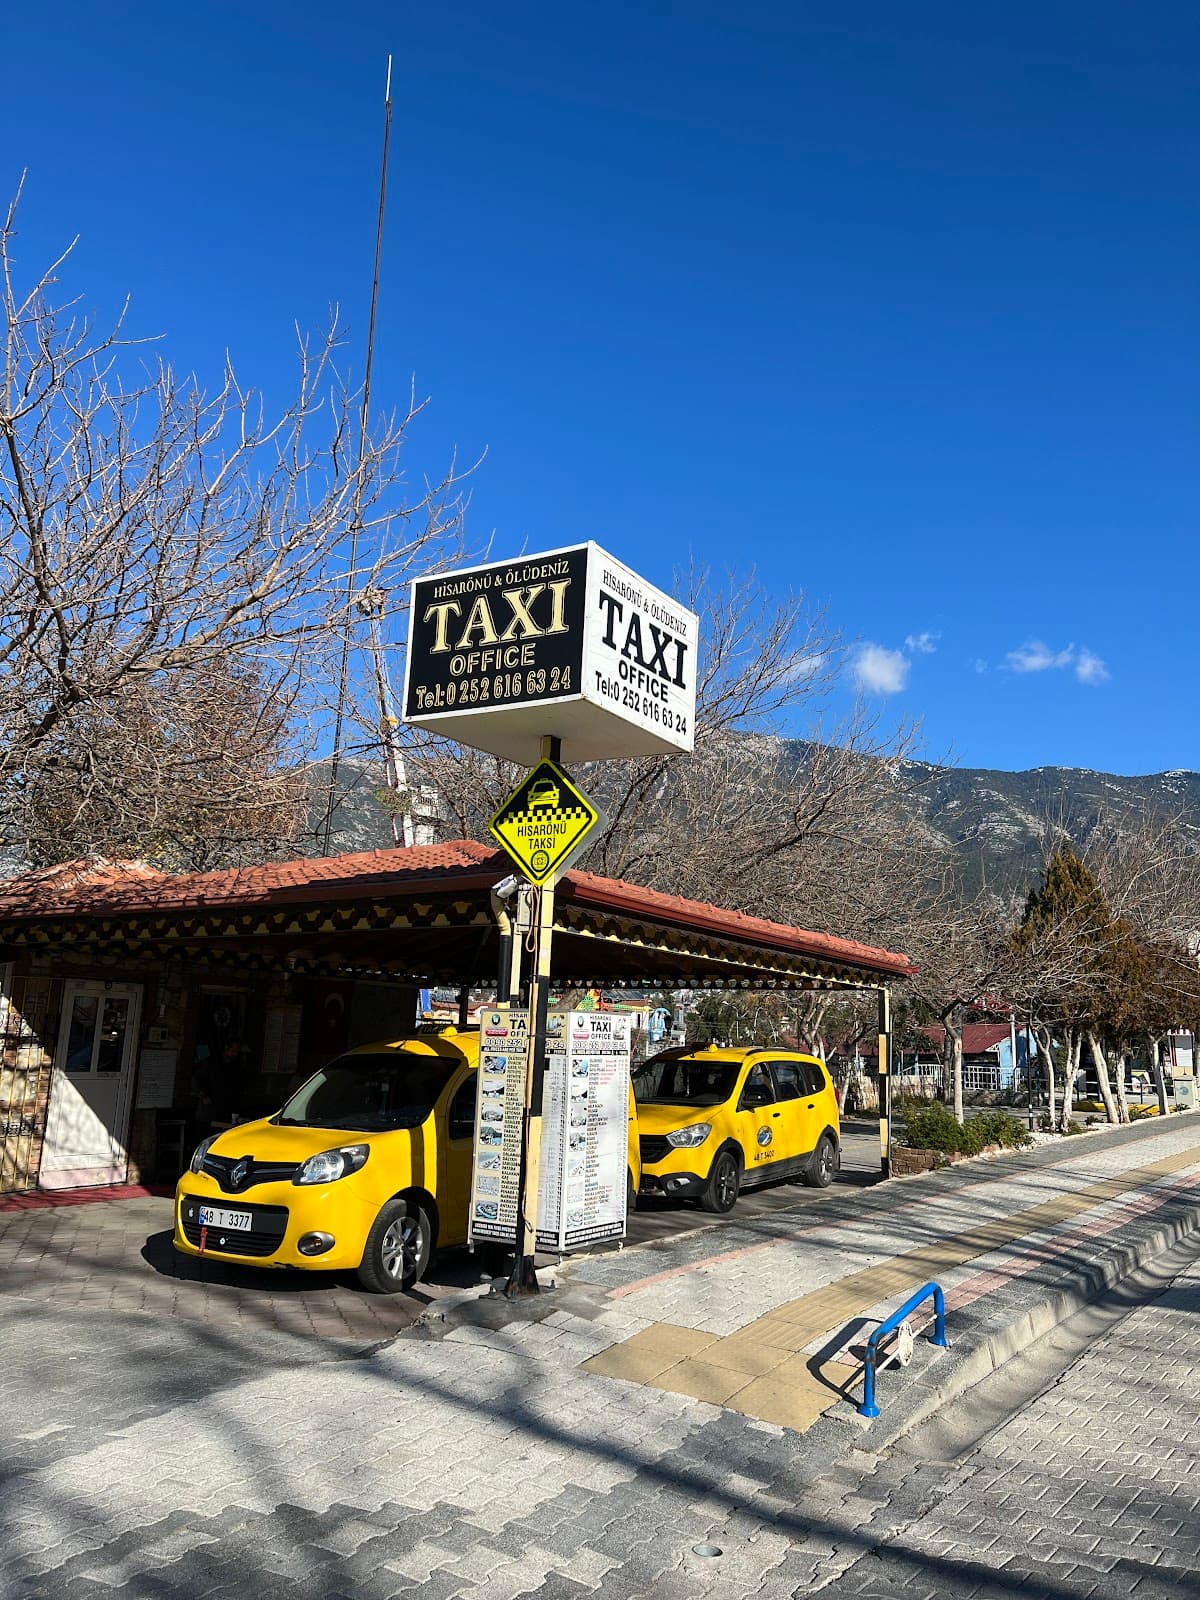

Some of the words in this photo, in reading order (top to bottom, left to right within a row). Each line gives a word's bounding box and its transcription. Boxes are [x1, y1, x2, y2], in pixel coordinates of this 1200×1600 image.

[434, 573, 492, 599] HİSARÖNÜ
[493, 574, 503, 587] &
[505, 558, 570, 585] ÖLÜDENİZ
[423, 578, 572, 655] TAXI
[643, 598, 650, 614] &
[599, 588, 688, 690] TAXI
[449, 642, 537, 677] OFFICE
[415, 682, 457, 709] Tel:0
[459, 677, 490, 704] 252
[493, 673, 522, 699] 616
[526, 668, 547, 695] 63
[549, 665, 571, 691] 24
[618, 659, 669, 703] OFFICE
[595, 670, 620, 702] Tel:0
[622, 686, 640, 713] 252
[642, 697, 660, 722] 616
[662, 707, 673, 729] 63
[675, 713, 687, 736] 24
[517, 820, 567, 838] HİSARÖNÜ
[509, 1019, 527, 1030] TA
[510, 1030, 526, 1038] OFF
[590, 1021, 612, 1033] TAXI
[204, 1209, 214, 1223] 48
[219, 1212, 224, 1225] T
[229, 1213, 250, 1228] 3377
